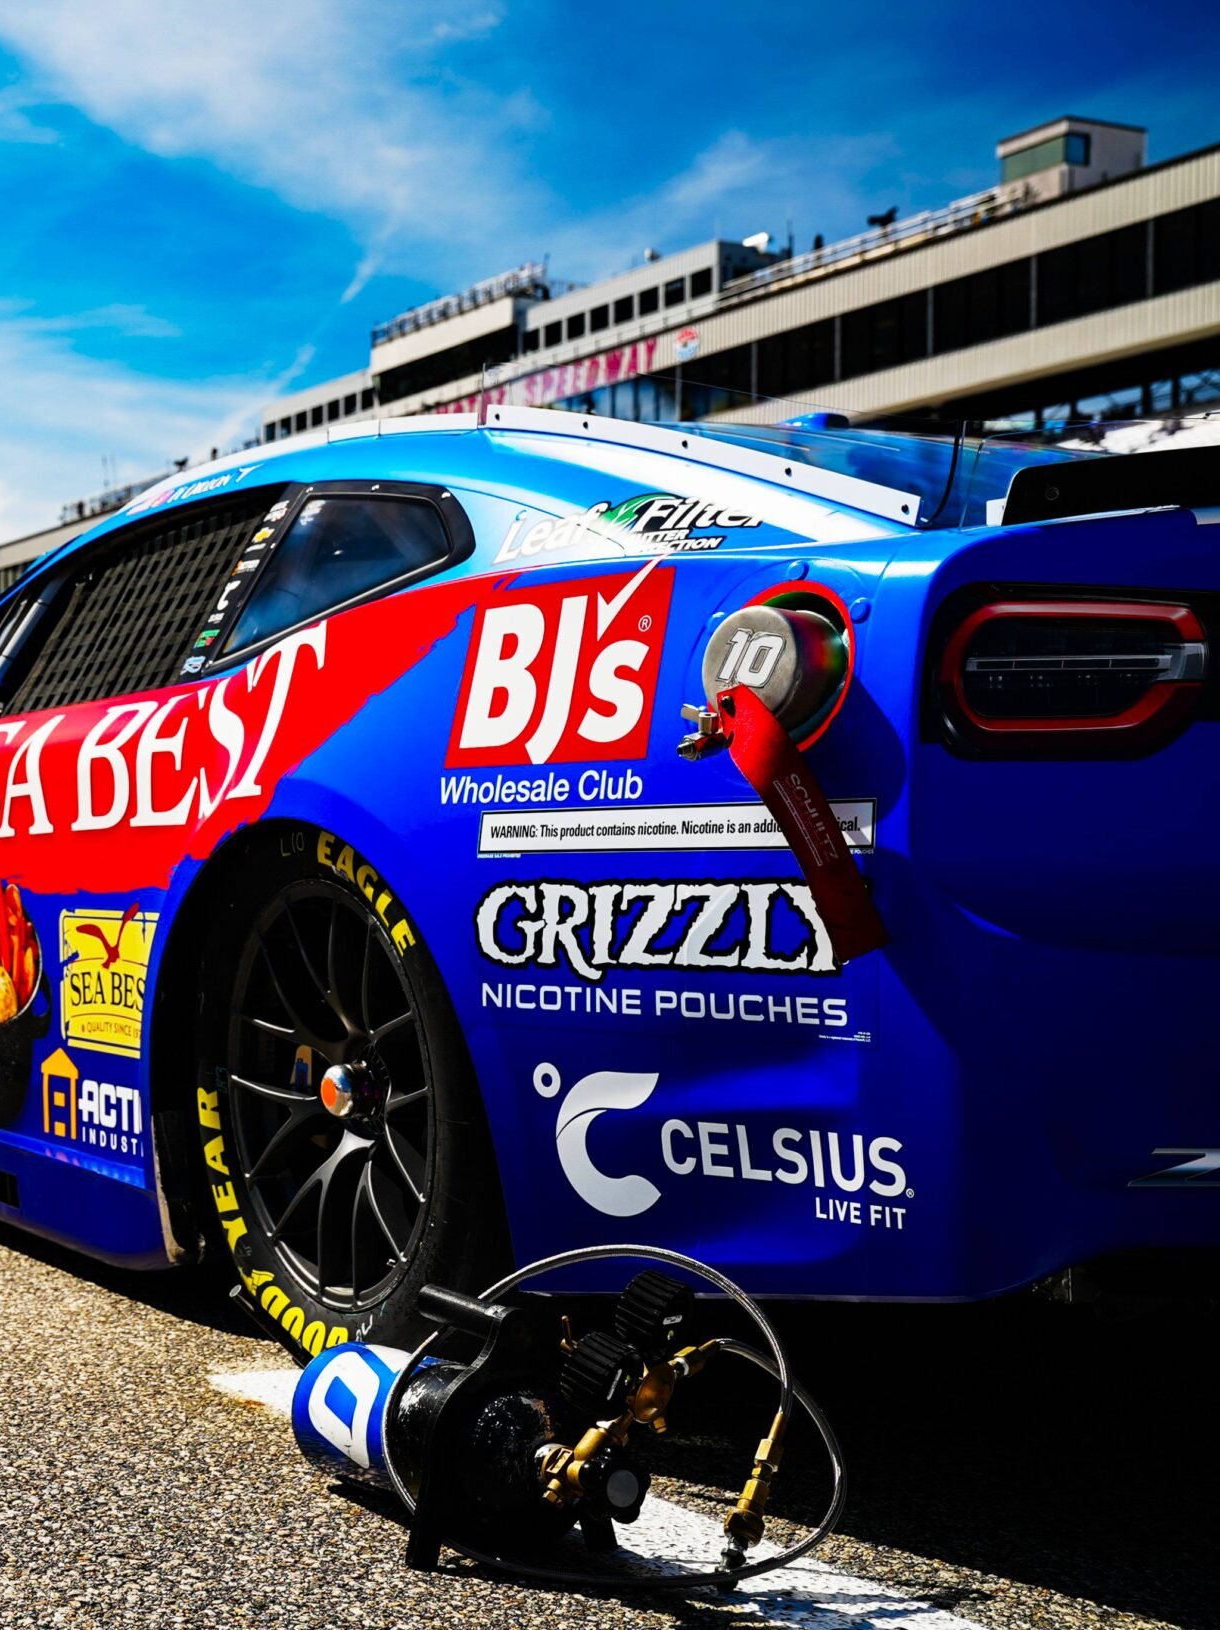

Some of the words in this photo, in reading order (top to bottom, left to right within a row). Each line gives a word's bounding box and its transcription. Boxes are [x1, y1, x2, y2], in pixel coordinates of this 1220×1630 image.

[491, 501, 611, 566] Leaf
[628, 496, 766, 530] Filter
[716, 626, 787, 690] 10
[70, 620, 328, 831] BEST
[440, 772, 570, 805] Wholesale
[577, 769, 644, 801] Club
[490, 824, 538, 839] WARNING:
[540, 824, 559, 837] This
[560, 823, 595, 840] product
[596, 822, 636, 836] contains
[637, 820, 679, 835] nicotine.
[681, 820, 725, 835] Nicotine
[726, 819, 736, 834] is
[737, 821, 750, 834] an
[316, 830, 417, 957] EAGLE
[476, 880, 838, 981] GRIZZLY
[70, 971, 106, 1007] SEA
[110, 972, 146, 1014] BES
[481, 982, 642, 1016] NICOTINE
[654, 990, 848, 1027] POUCHES
[78, 1079, 142, 1134] ACTI
[82, 1126, 144, 1157] INDUST
[660, 1118, 907, 1198] CELSIUS
[815, 1197, 862, 1225] LIVE
[870, 1205, 907, 1231] FIT
